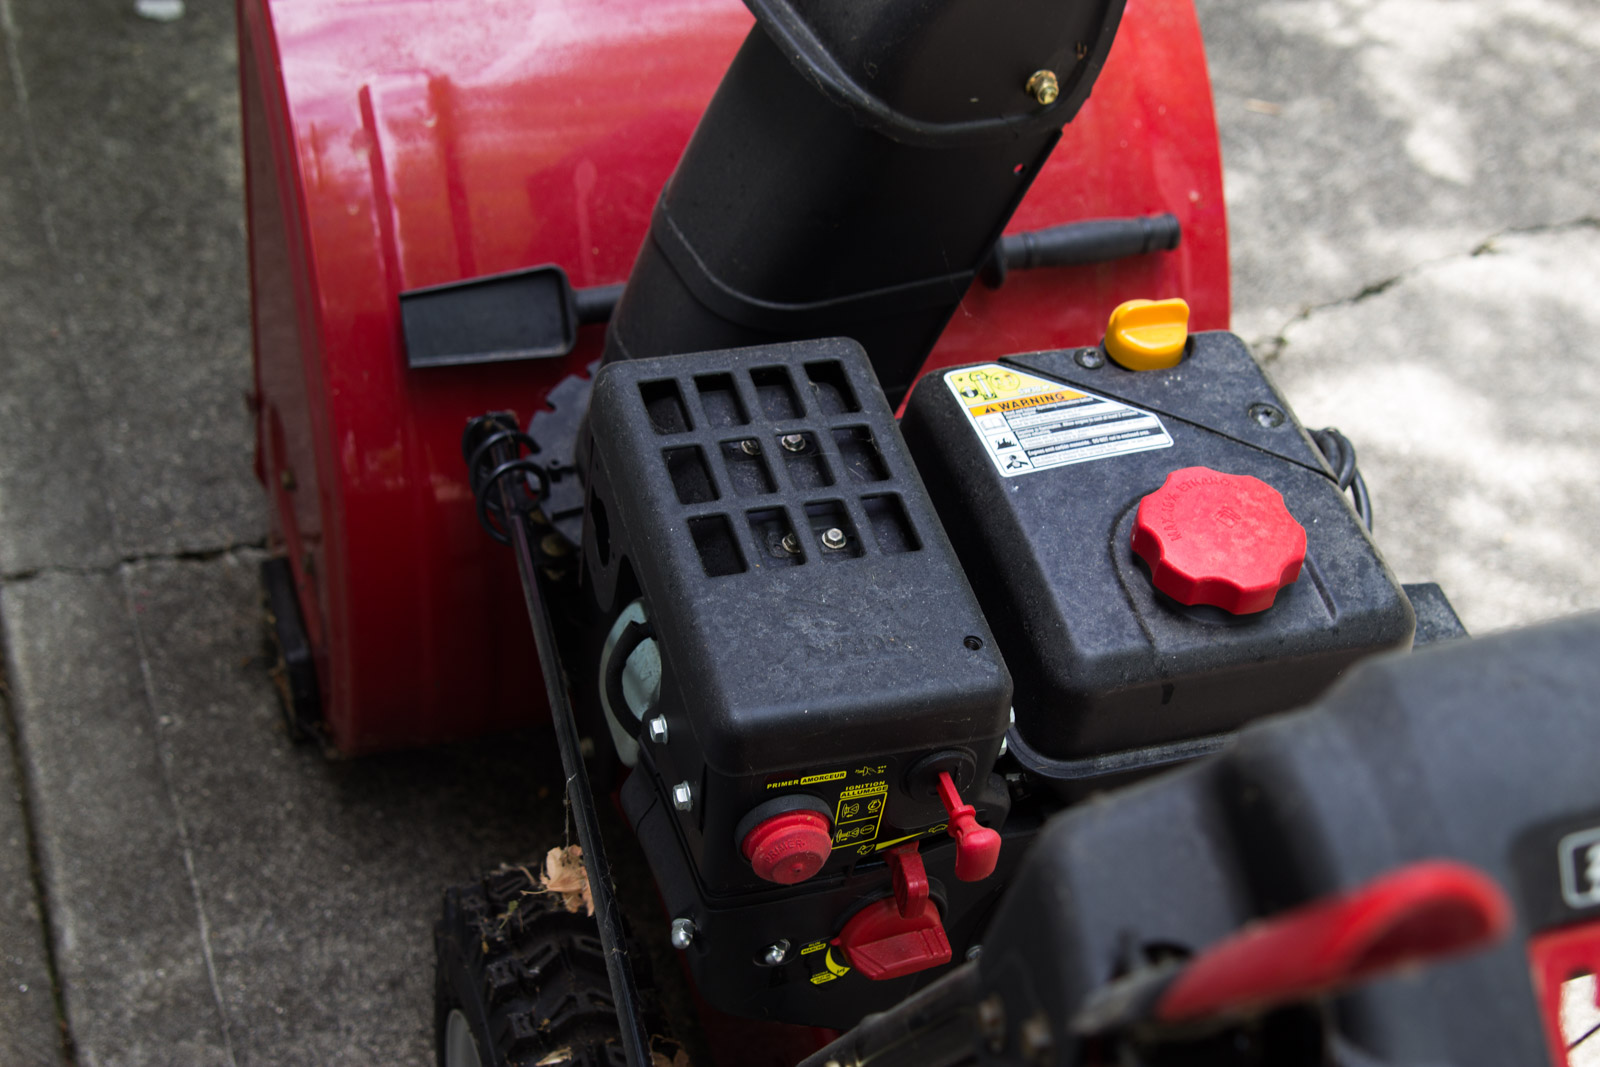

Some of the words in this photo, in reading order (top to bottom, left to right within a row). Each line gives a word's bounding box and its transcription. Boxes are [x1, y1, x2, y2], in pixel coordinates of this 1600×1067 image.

[998, 393, 1065, 410] WARNING
[766, 779, 800, 790] PRIMER
[801, 772, 846, 784] AMORCEUR
[845, 780, 886, 791] IGNITION
[841, 785, 888, 798] ALLUMAGE
